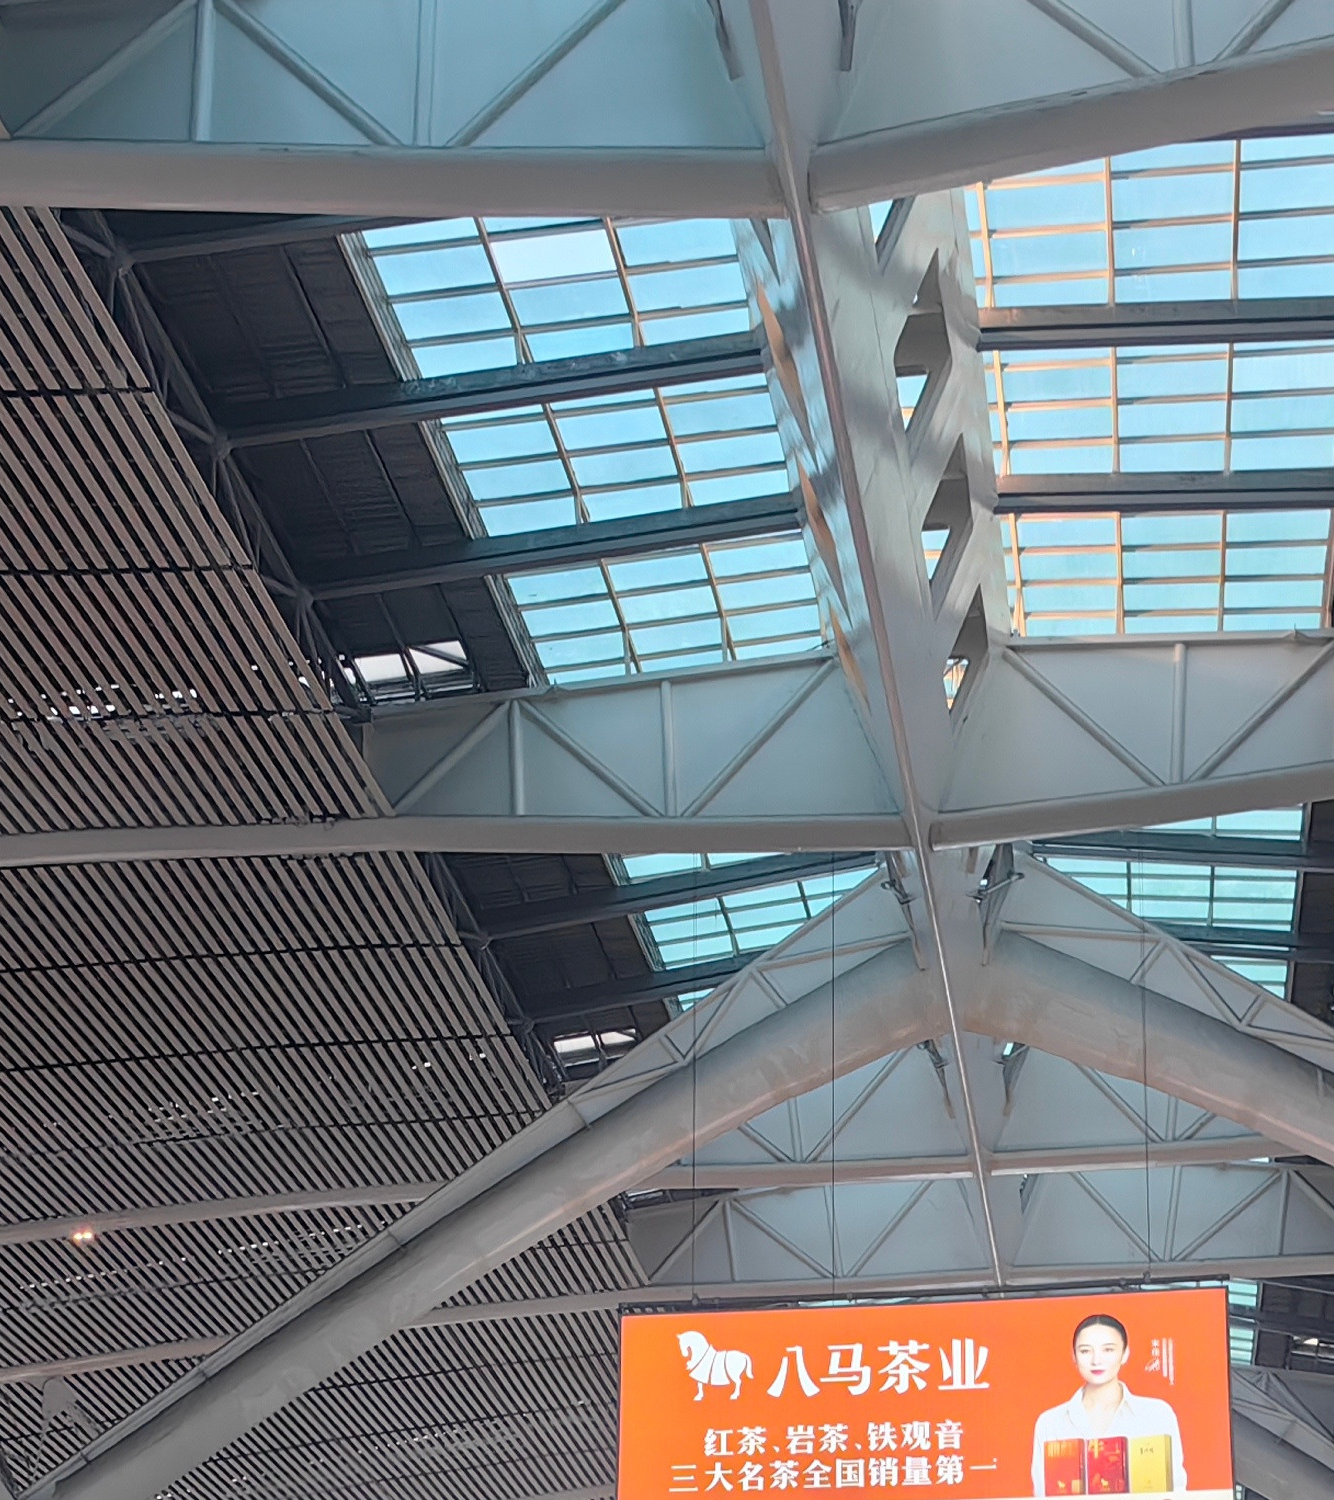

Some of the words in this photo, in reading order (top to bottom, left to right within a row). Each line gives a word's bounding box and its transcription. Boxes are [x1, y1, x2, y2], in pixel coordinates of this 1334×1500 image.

[766, 1338, 991, 1397] 八马茶业
[704, 1419, 964, 1457] 红茶、岩茶、铁观音
[669, 1455, 998, 1493] 三大名茶全国销量第一
